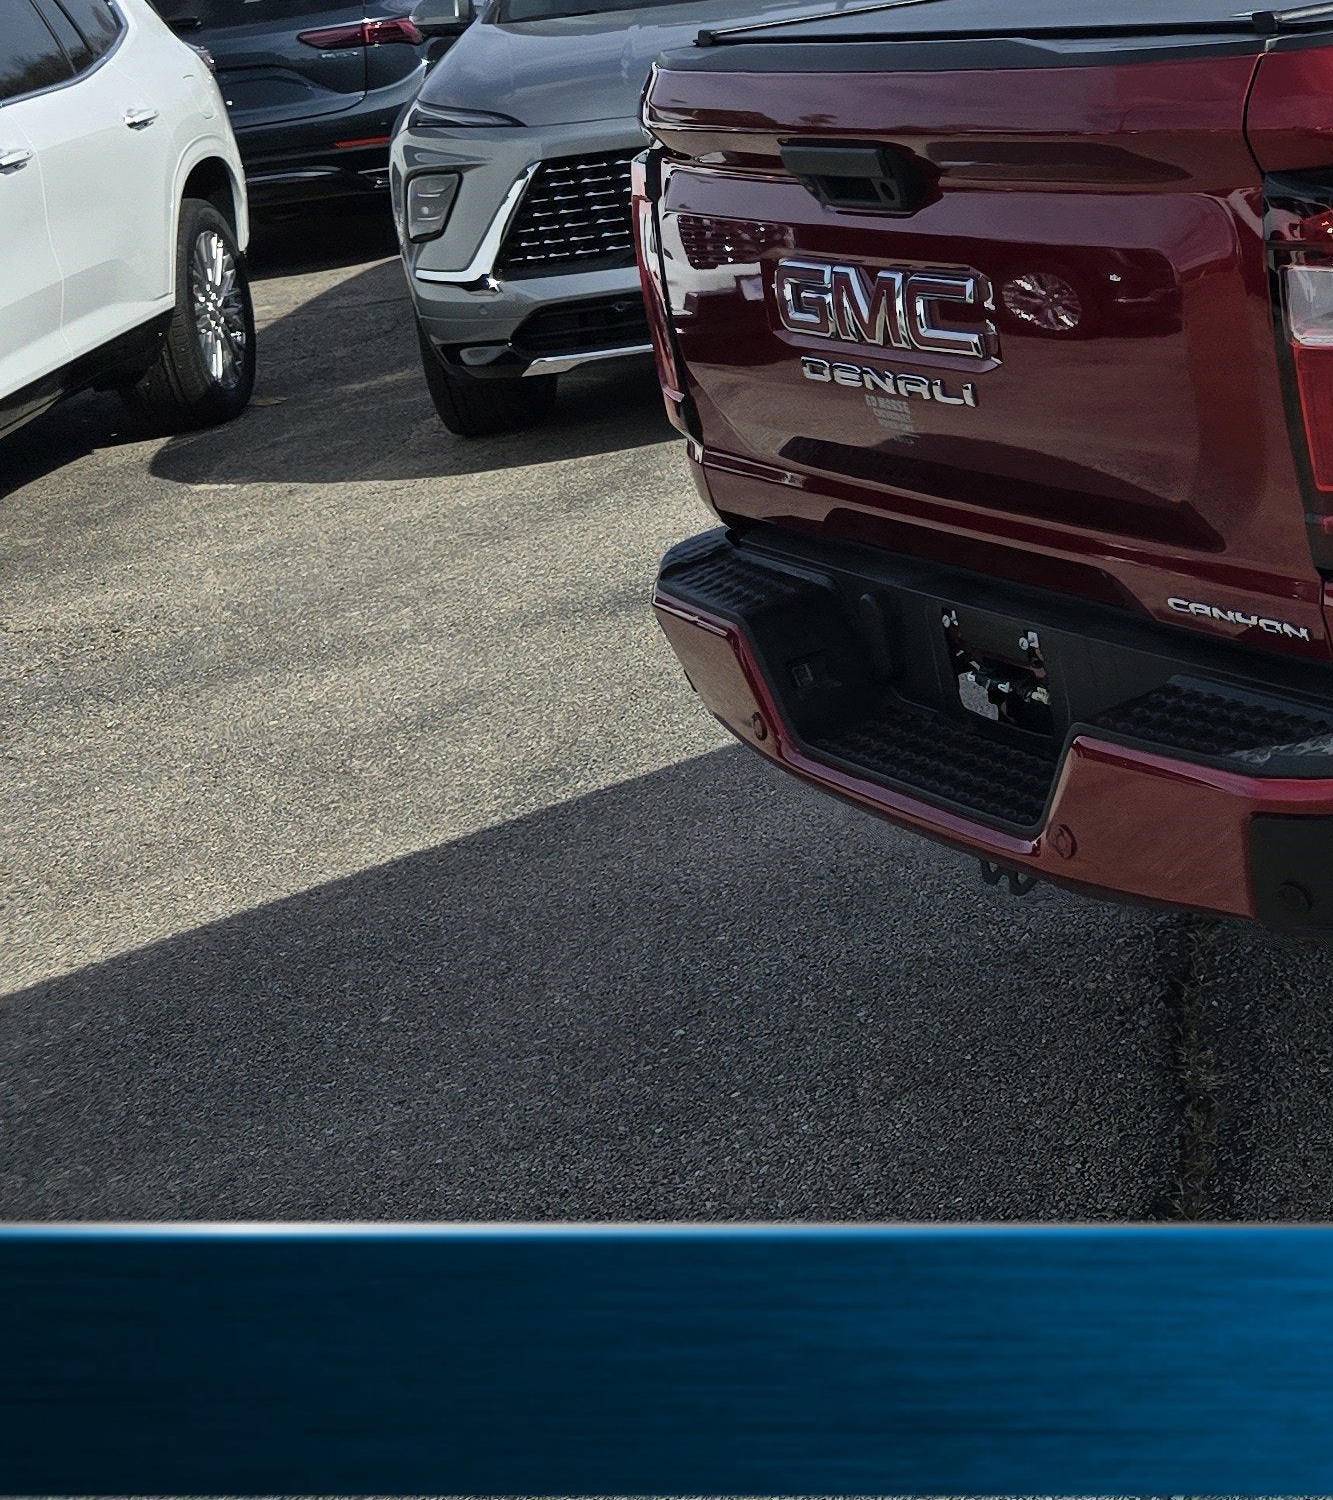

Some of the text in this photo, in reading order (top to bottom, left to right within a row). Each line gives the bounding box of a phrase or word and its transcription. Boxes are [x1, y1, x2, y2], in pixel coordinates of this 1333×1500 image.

[774, 257, 985, 359] GMC
[801, 355, 977, 408] DENALI
[1167, 597, 1310, 642] CANYON
